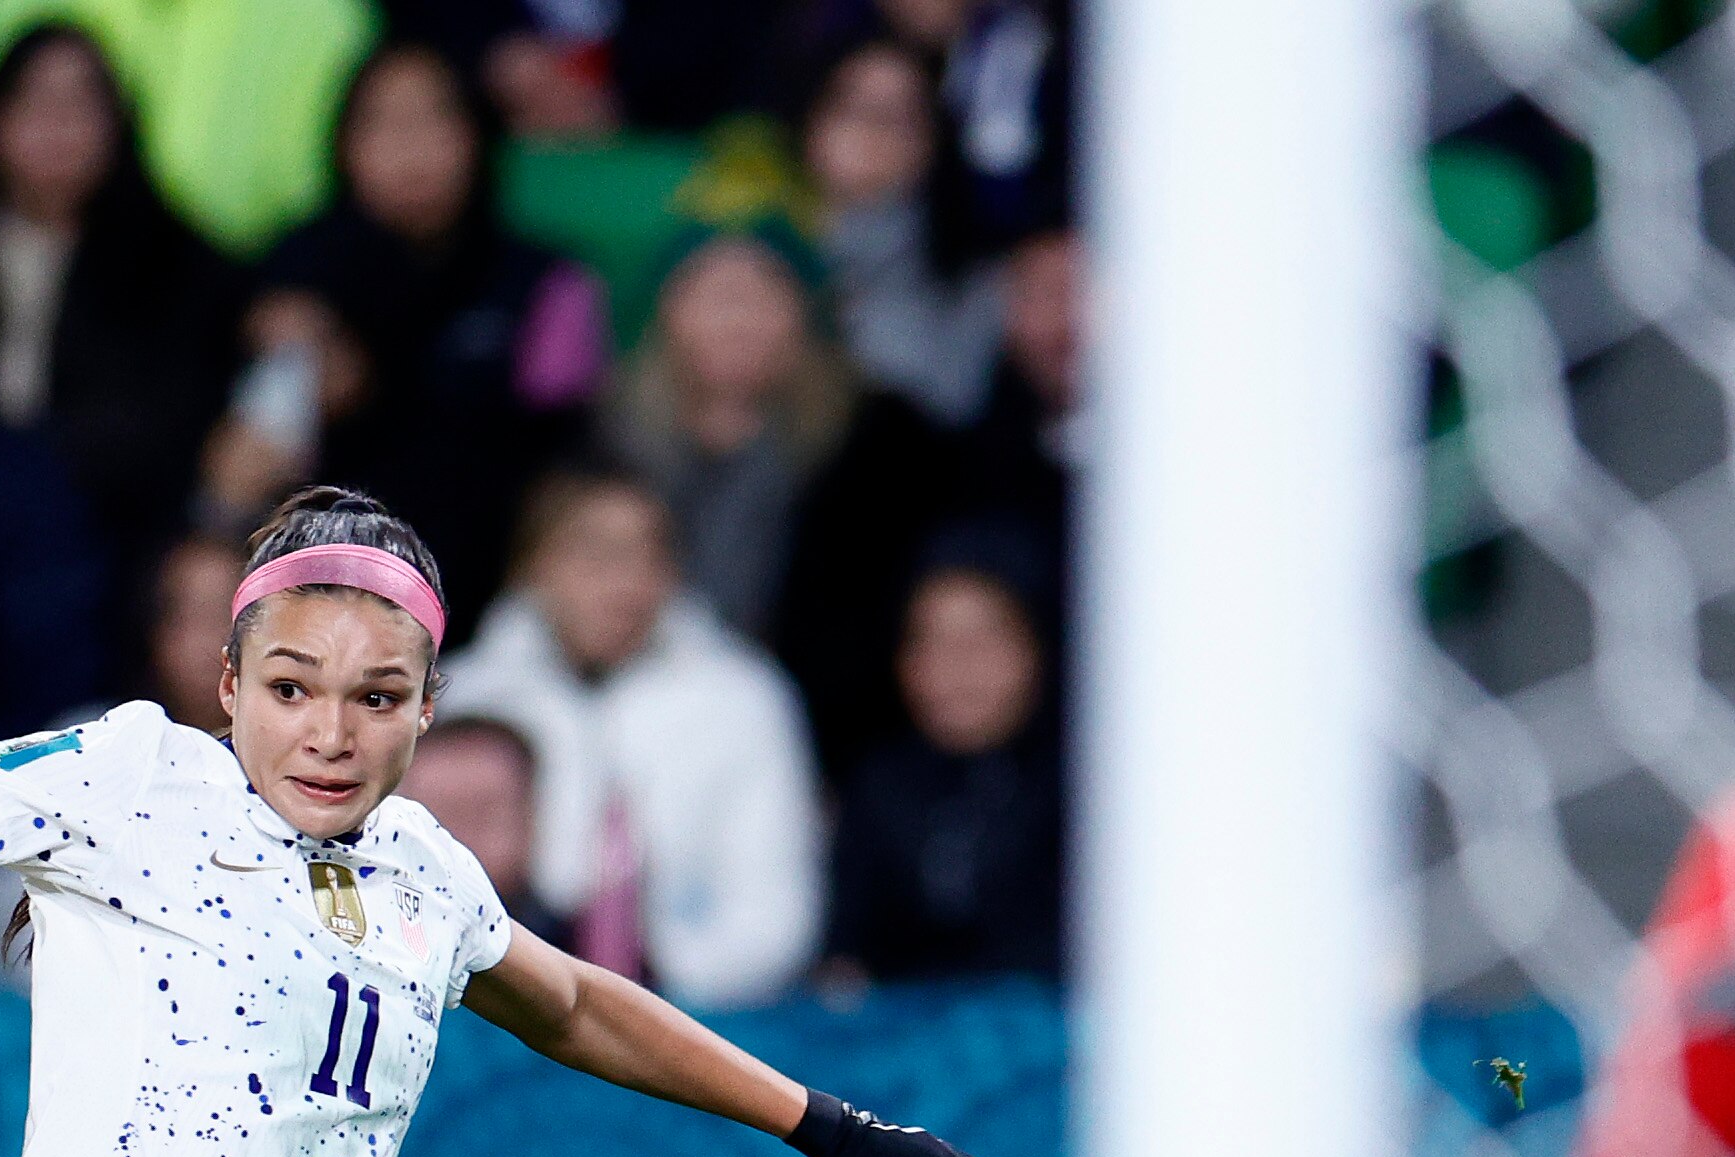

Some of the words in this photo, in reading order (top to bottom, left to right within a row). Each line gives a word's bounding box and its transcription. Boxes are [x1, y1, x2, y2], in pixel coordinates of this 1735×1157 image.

[394, 888, 420, 921] USA
[330, 916, 357, 931] FIFA
[309, 971, 380, 1110] 11
